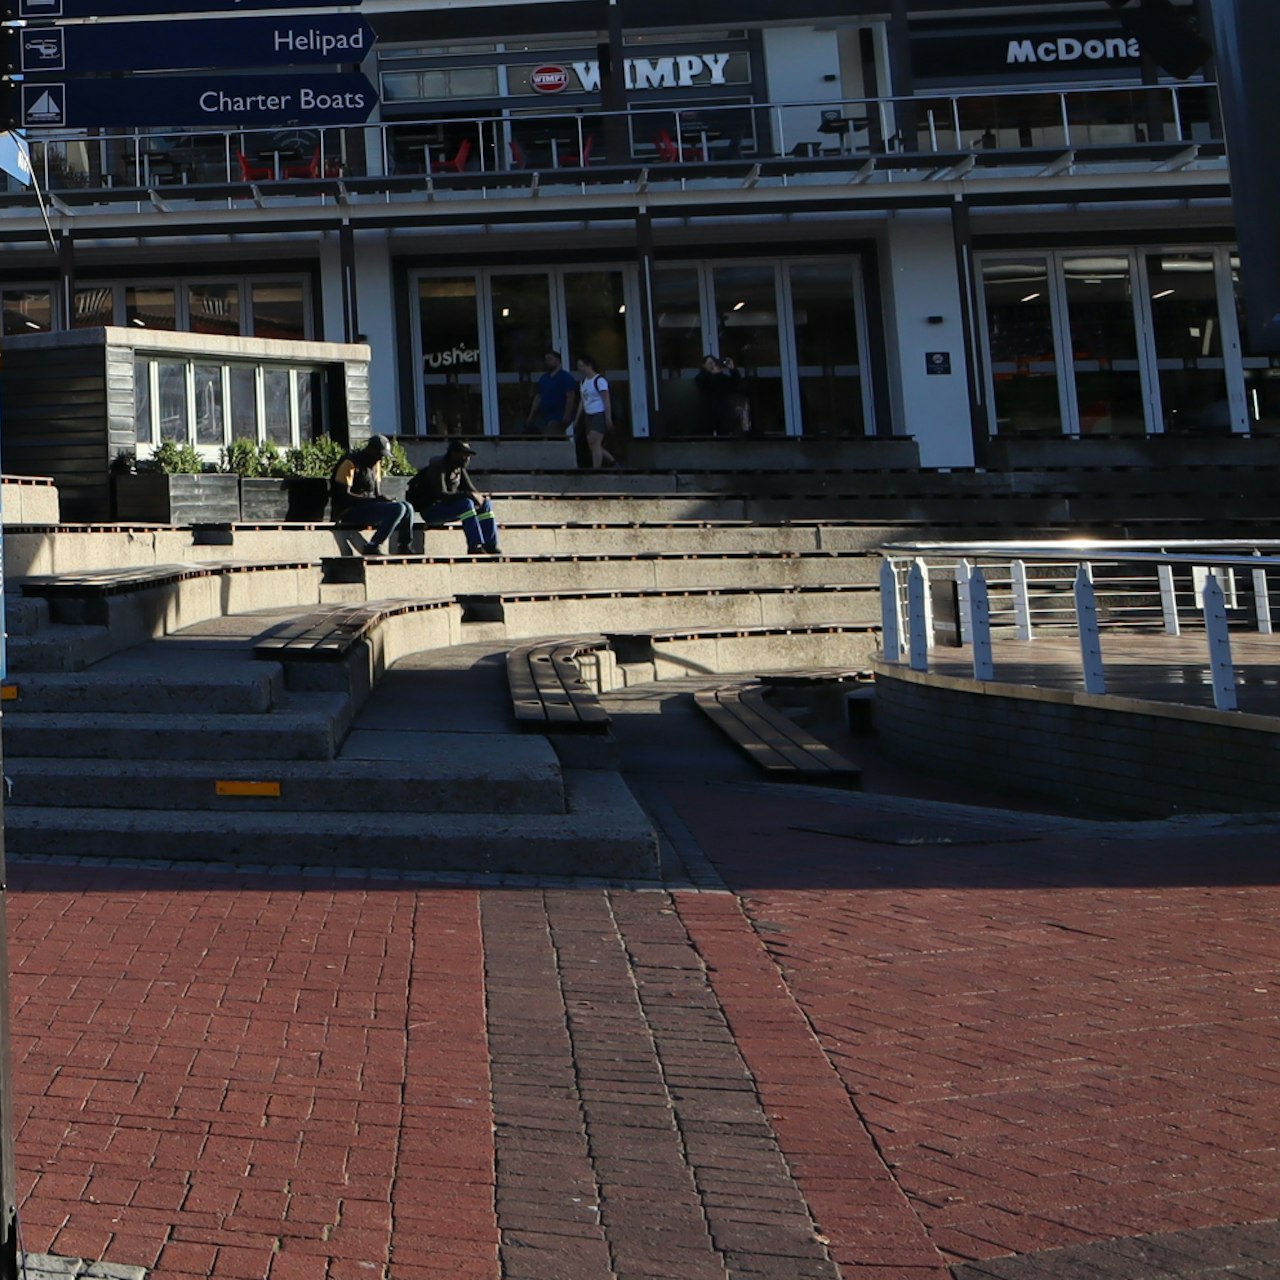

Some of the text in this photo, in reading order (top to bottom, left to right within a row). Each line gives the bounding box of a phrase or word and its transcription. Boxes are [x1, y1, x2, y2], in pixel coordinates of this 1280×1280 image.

[273, 28, 364, 54] Helipad
[1007, 37, 1140, 64] McDona
[533, 74, 566, 84] WIMPY
[573, 53, 730, 92] WIMPY
[199, 87, 365, 113] Charter Boats
